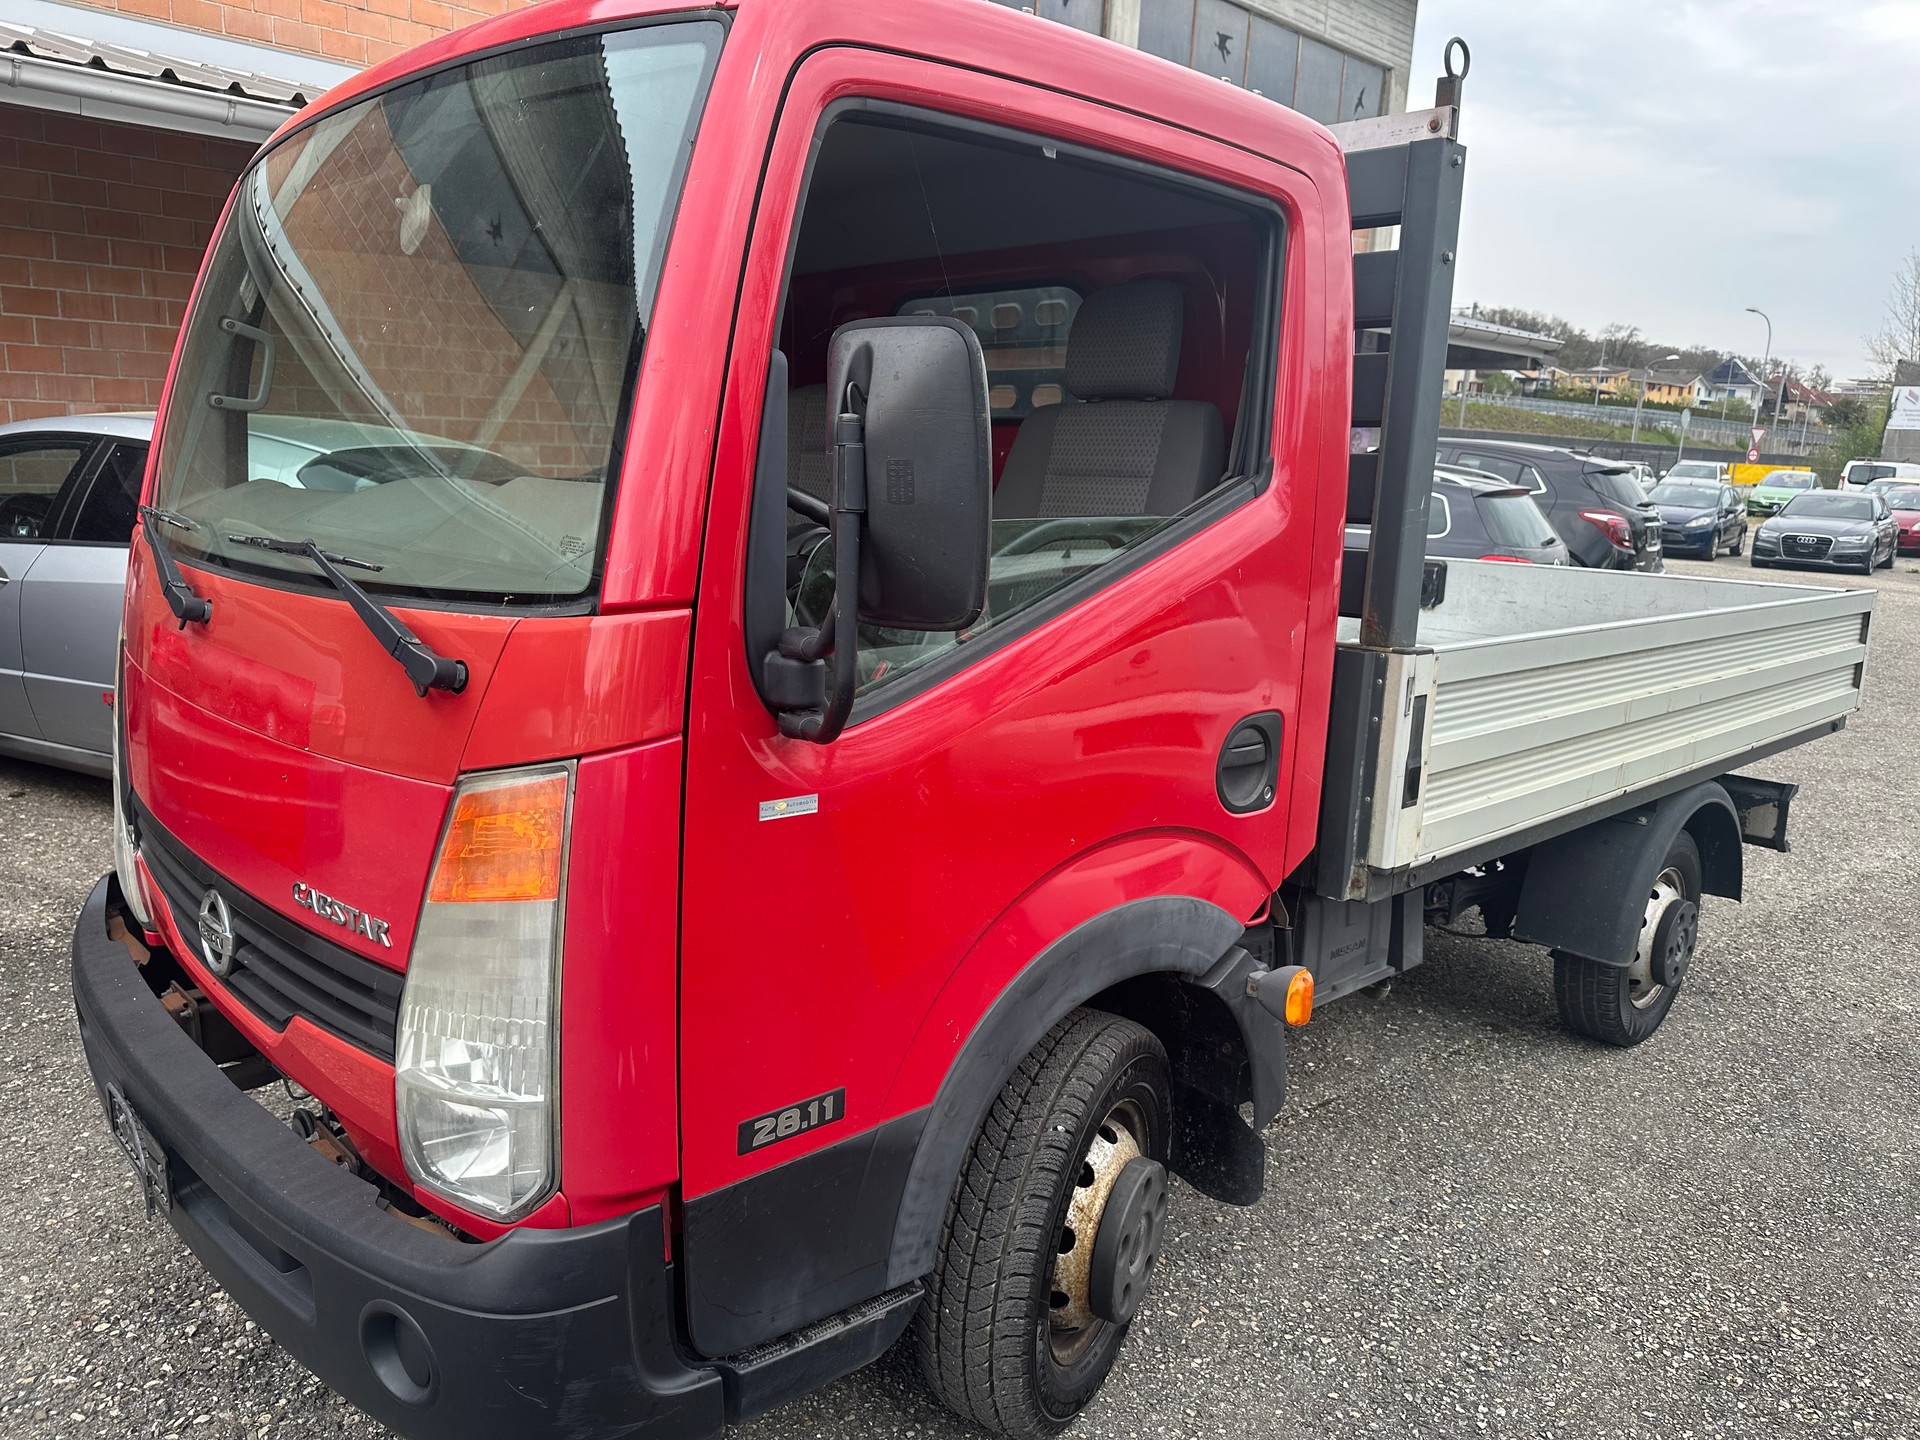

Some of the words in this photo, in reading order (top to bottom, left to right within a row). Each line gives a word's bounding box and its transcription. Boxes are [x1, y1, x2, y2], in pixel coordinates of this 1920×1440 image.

[292, 881, 393, 948] CABSTAR
[1330, 938, 1366, 960] NISSAN
[752, 1095, 834, 1147] 28.11
